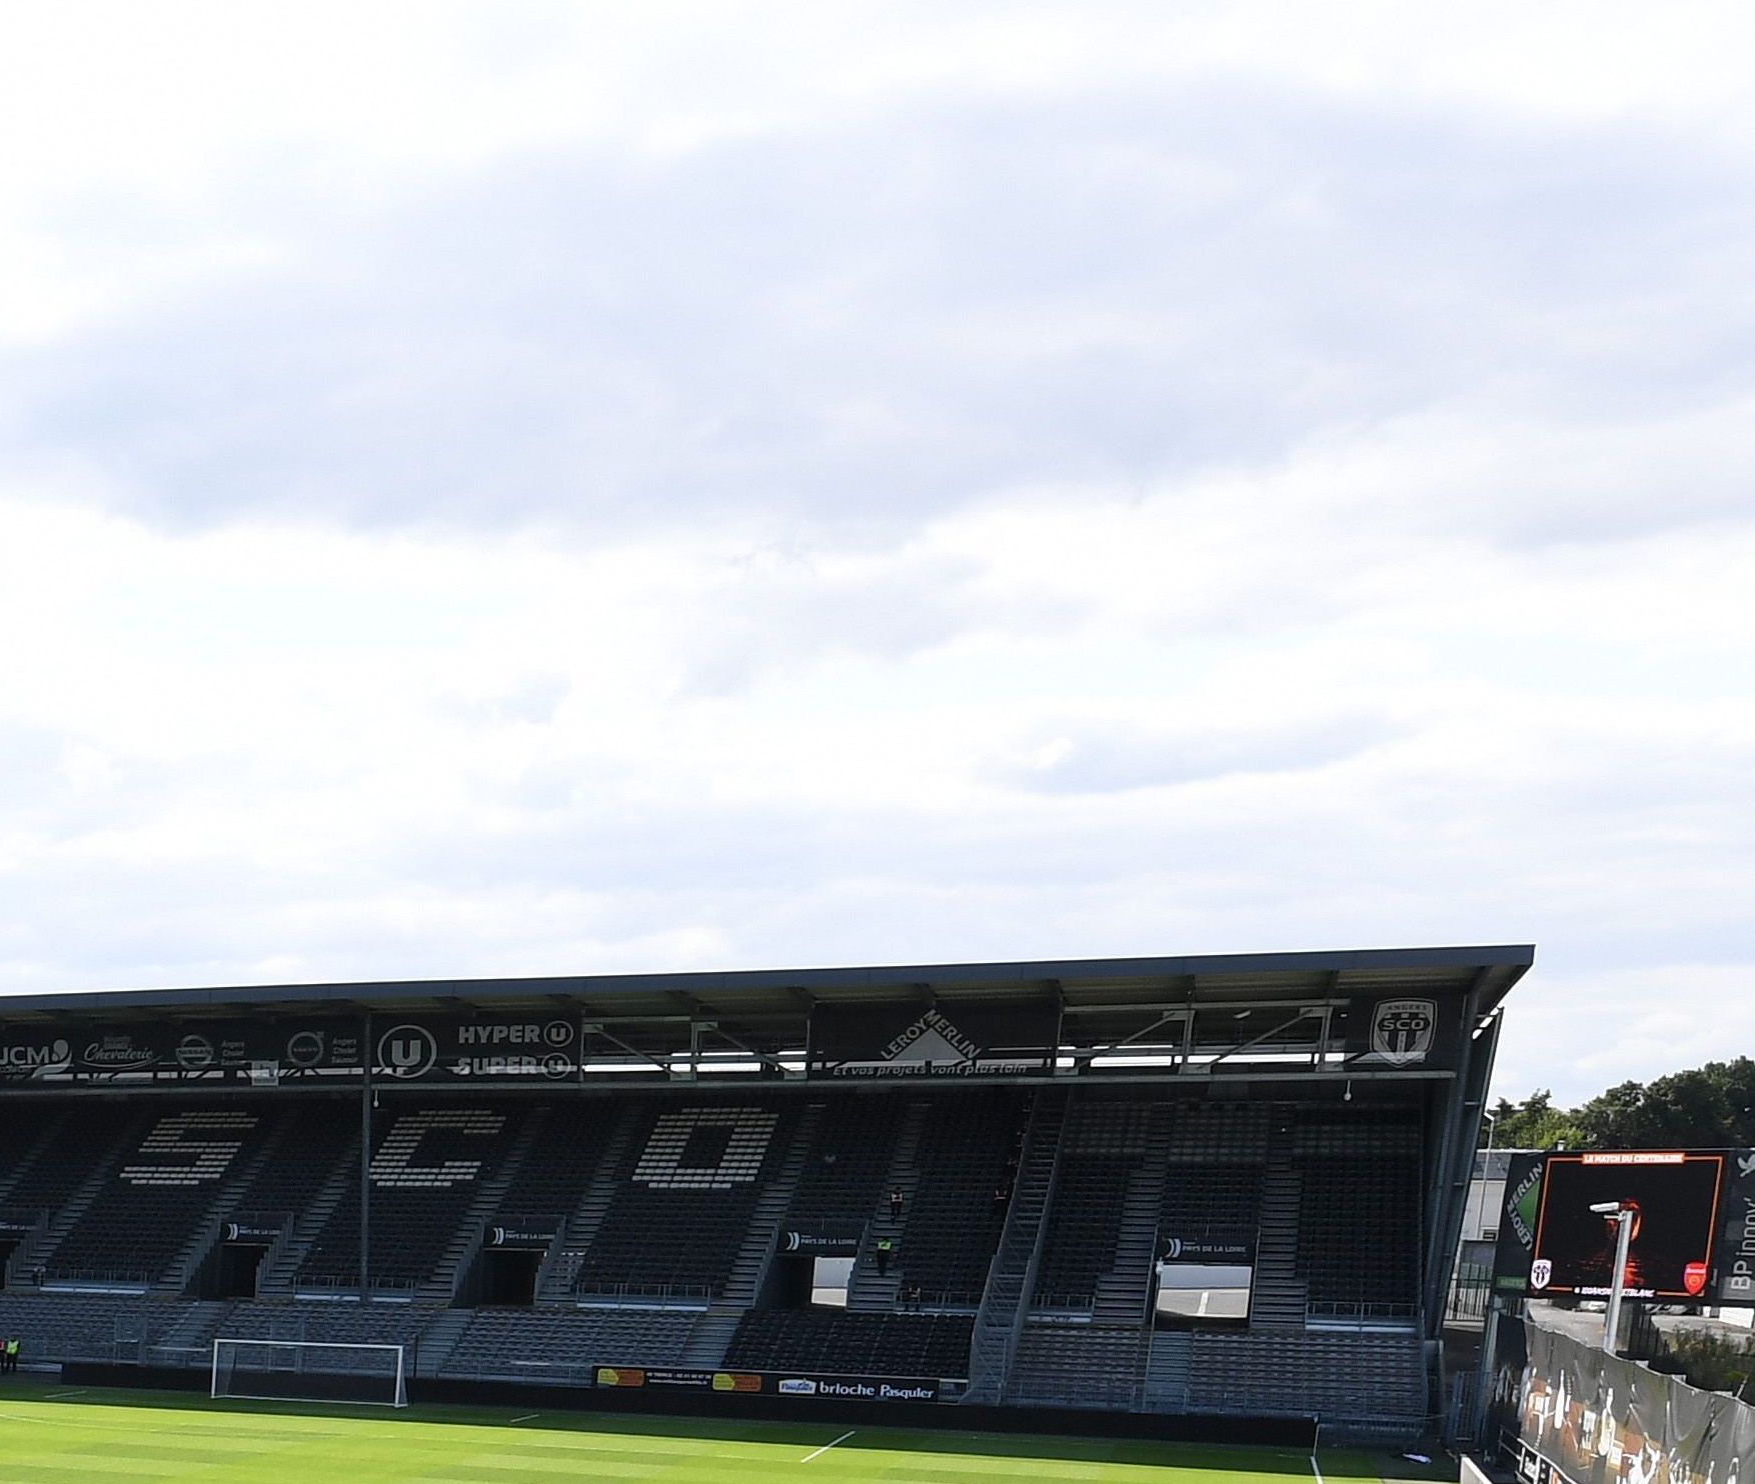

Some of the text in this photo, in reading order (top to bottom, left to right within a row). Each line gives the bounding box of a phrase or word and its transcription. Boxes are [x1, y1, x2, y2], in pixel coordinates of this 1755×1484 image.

[880, 1008, 982, 1060] LEROY MERLIN
[1383, 1020, 1424, 1030] SCO
[458, 1025, 540, 1044] HYPER
[392, 1040, 421, 1065] U
[458, 1057, 540, 1075] SUPER
[851, 1067, 874, 1076] vos
[876, 1065, 926, 1077] projets
[930, 1065, 963, 1075] vont
[964, 1064, 996, 1077] plus
[999, 1064, 1027, 1075] loin
[1731, 1260, 1752, 1289] BP
[819, 1381, 875, 1396] brioche
[880, 1384, 935, 1399] Pasquier
